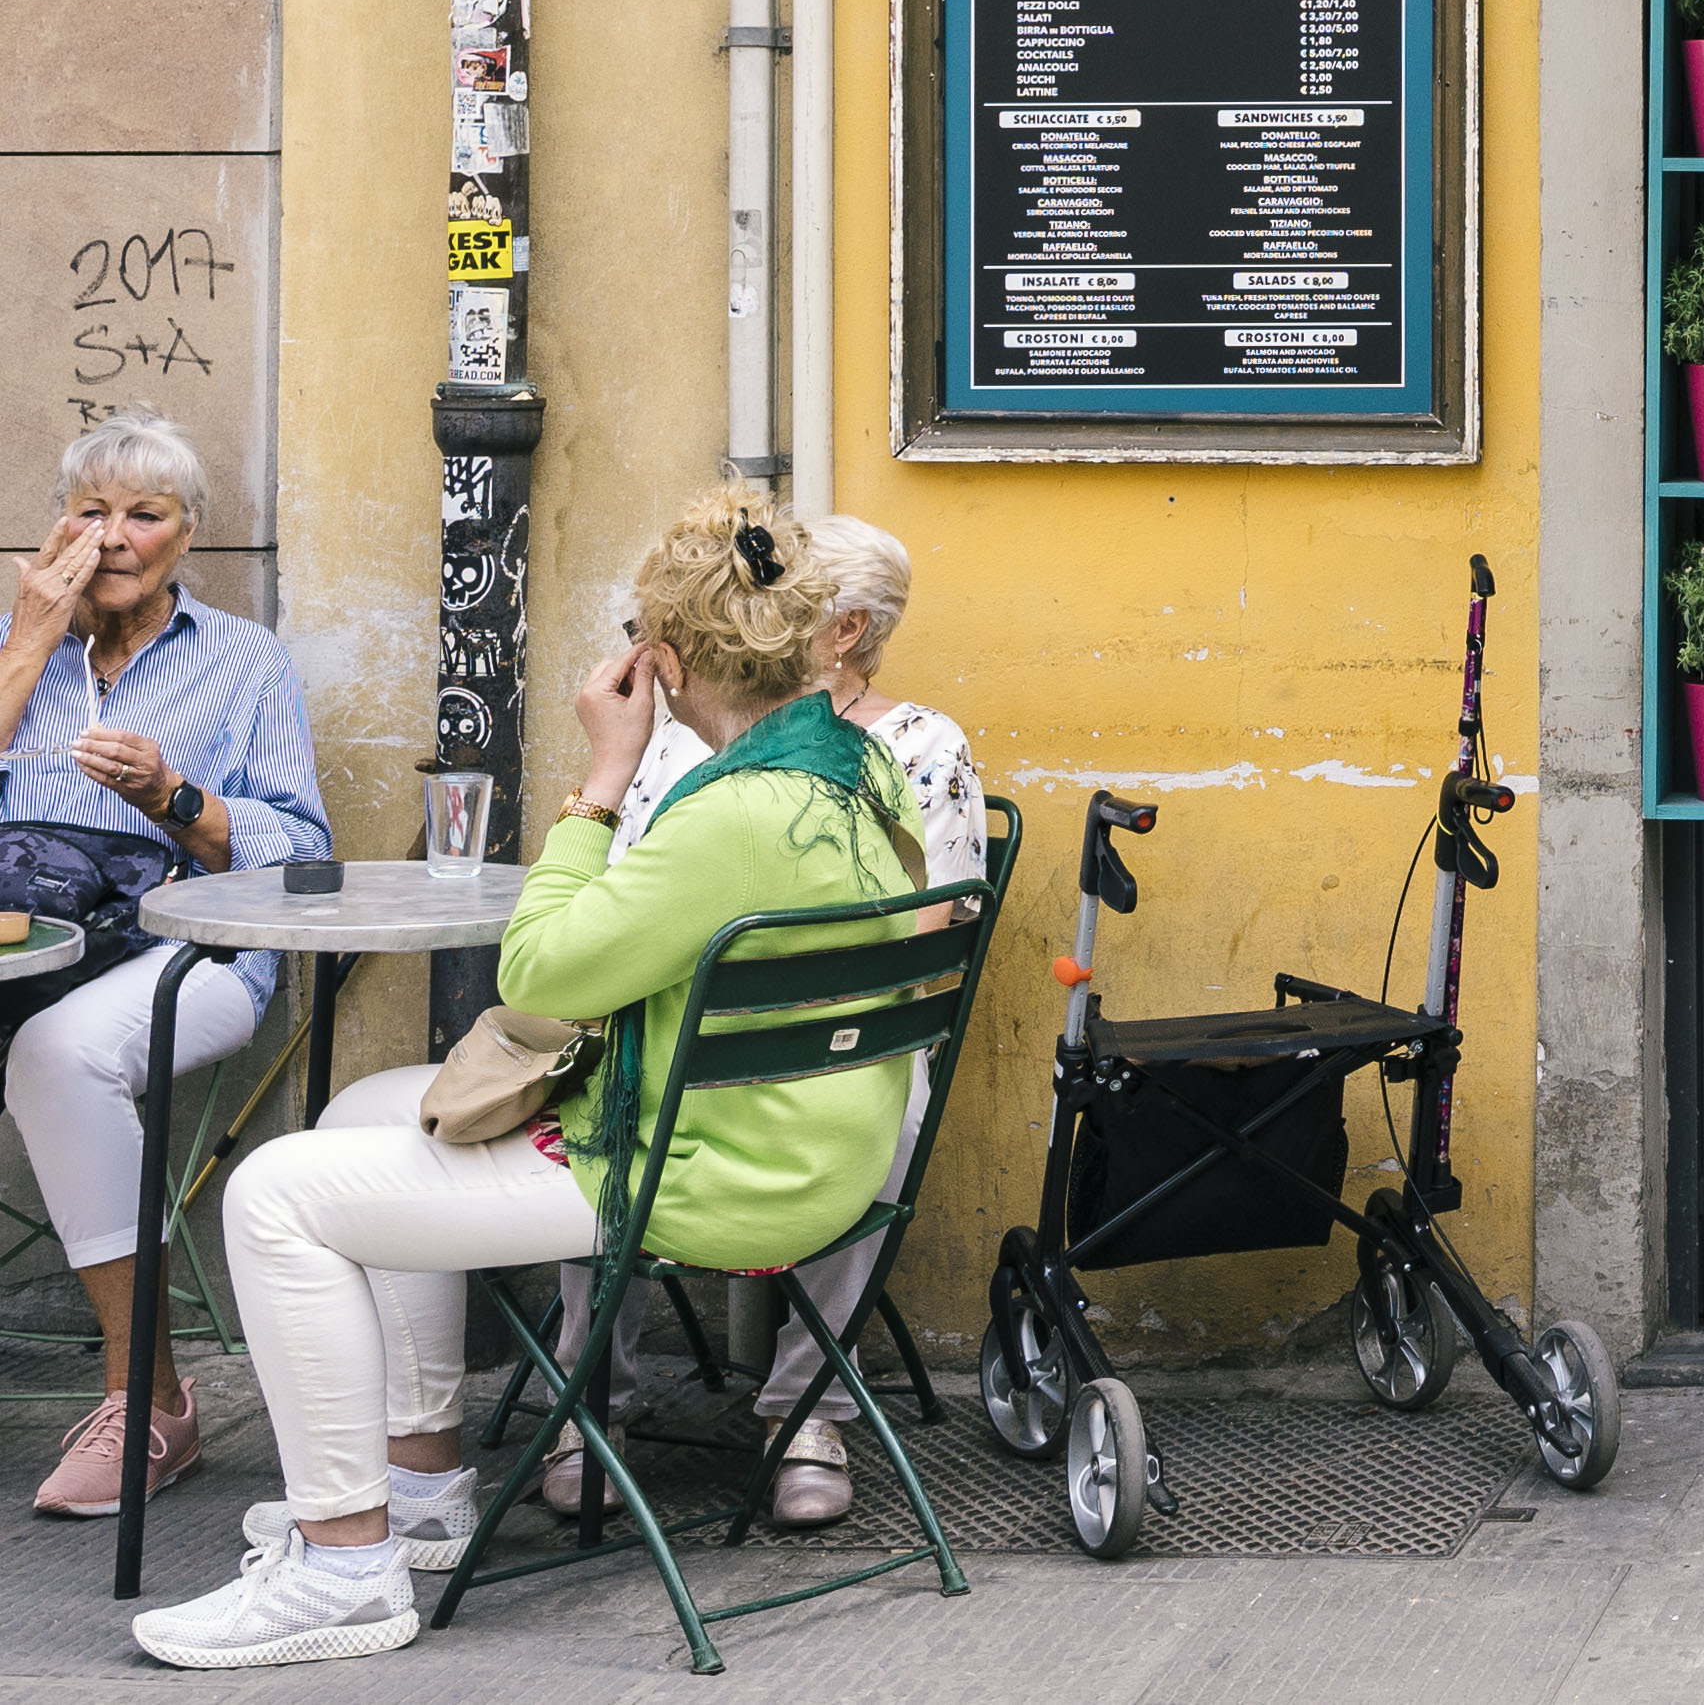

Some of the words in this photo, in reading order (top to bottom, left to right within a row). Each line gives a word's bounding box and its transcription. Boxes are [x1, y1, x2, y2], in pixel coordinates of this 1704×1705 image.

[1017, 1, 1045, 10] PEZZI
[1048, 1, 1080, 10] DOLCI
[1299, 0, 1356, 9] €1,20/1,40
[1017, 14, 1052, 23] SALATI
[1299, 12, 1307, 21] €
[1309, 12, 1359, 21] 3,50/7,00
[1017, 26, 1048, 35] BIRRA
[1050, 26, 1058, 35] IN
[1060, 26, 1114, 35] BOTTIGLIA
[1299, 24, 1307, 34] €
[1309, 24, 1359, 34] 3,00/5,00
[1017, 38, 1085, 47] CAPPUCCINO
[1300, 37, 1307, 46] €
[1309, 37, 1332, 46] 1,80
[1017, 51, 1073, 60] COCKTAILS
[1300, 48, 1307, 58] €
[1309, 48, 1359, 58] 5,00/7,00
[1017, 63, 1079, 72] ANALCOLICI
[1300, 61, 1307, 71] €
[1309, 61, 1359, 71] 2,50/4,00
[1017, 76, 1055, 84] SUCCHI
[1300, 73, 1307, 83] €
[1309, 73, 1332, 83] 3,00
[1017, 88, 1058, 97] LATTINE
[1300, 85, 1307, 95] €
[1309, 85, 1332, 95] 2,50
[1014, 114, 1089, 124] SCHIACCIATE
[1235, 113, 1312, 123] SANDWICHES
[1041, 133, 1099, 142] DONATELLO:
[1261, 132, 1320, 140] DONATELLO:
[1043, 154, 1097, 164] MASACCIO:
[1264, 154, 1318, 162] MASACCIO:
[1043, 176, 1097, 186] BOTTICELLI:
[1264, 175, 1318, 184] BOTTICELLI:
[1038, 198, 1102, 208] CARAVAGGIO:
[1258, 197, 1324, 206] CARAVAGGIO:
[1049, 221, 1091, 230] TIZIANO:
[1270, 219, 1311, 228] TIZIANO:
[1043, 243, 1097, 252] RAFFAELLO:
[1263, 241, 1318, 251] RAFFAELLO:
[70, 228, 235, 310] 2017
[1022, 277, 1080, 287] INSALATE
[1248, 276, 1296, 286] SALADS
[1017, 334, 1083, 344] CROSTONI
[1238, 333, 1304, 343] CROSTONI
